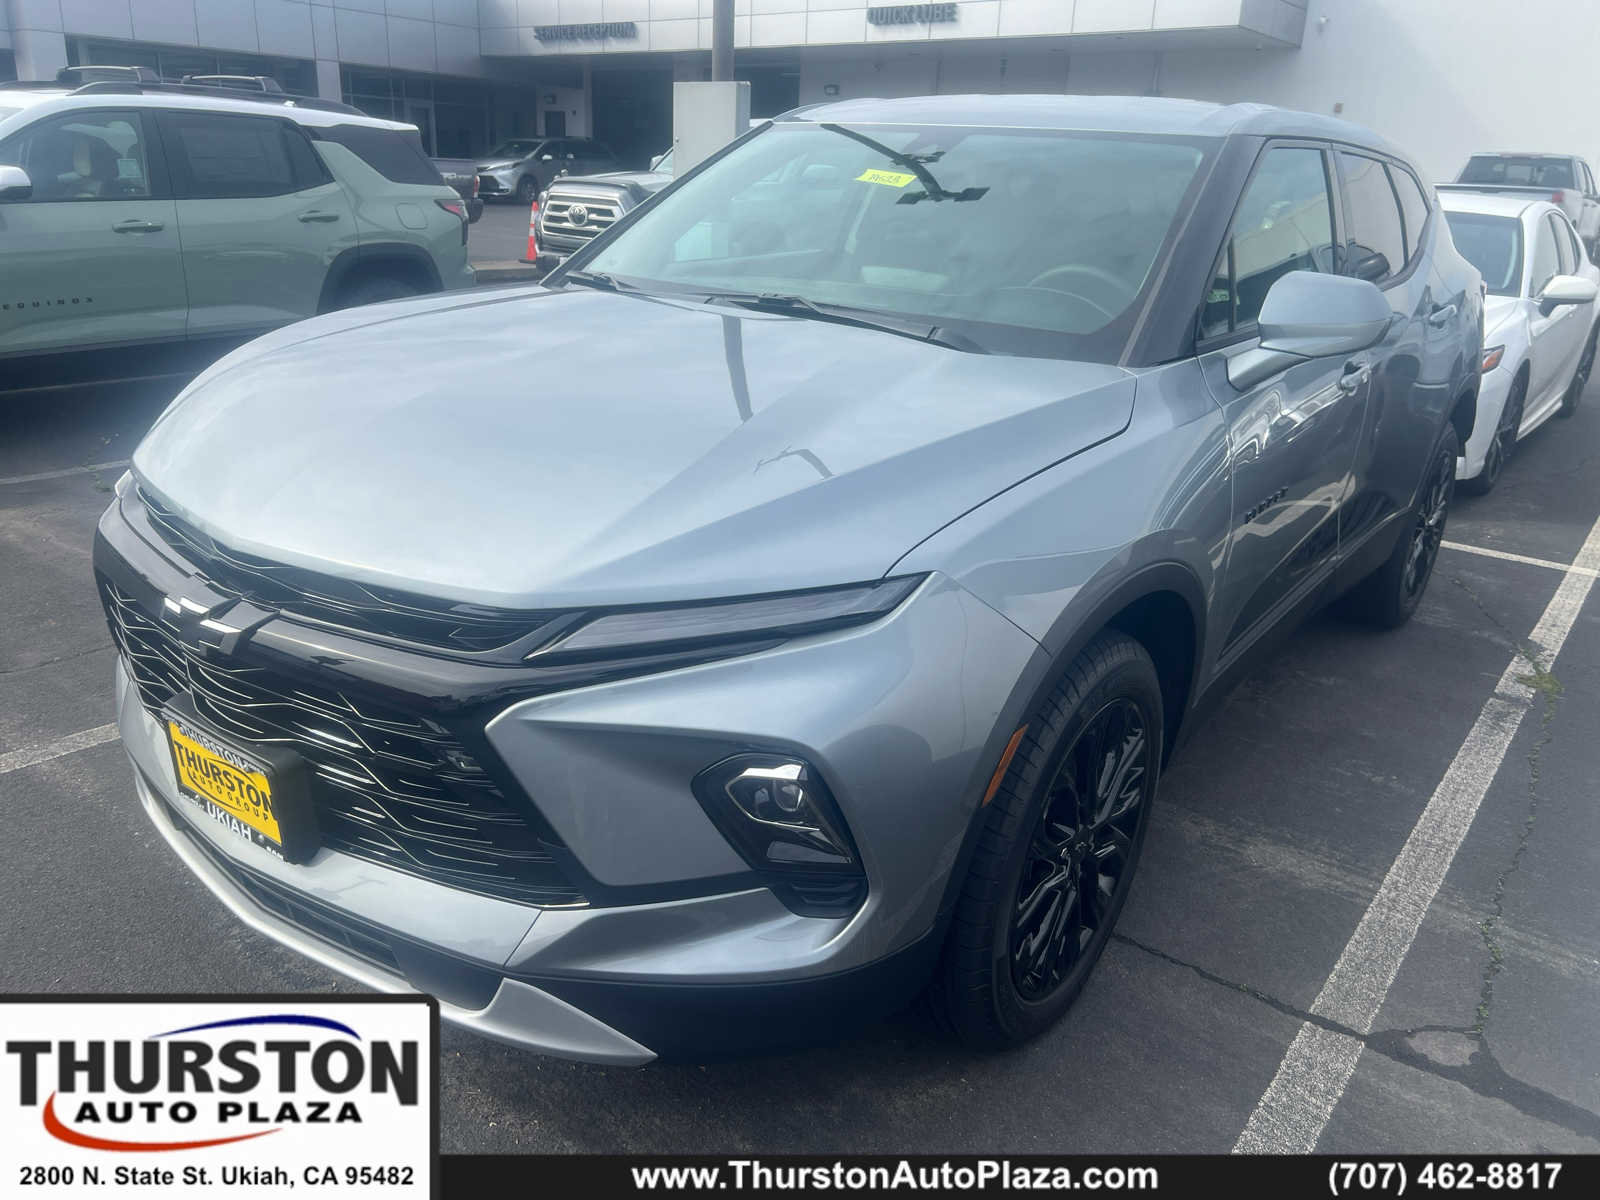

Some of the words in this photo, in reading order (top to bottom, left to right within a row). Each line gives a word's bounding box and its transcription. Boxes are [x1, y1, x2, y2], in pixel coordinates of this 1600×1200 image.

[868, 6, 914, 25] QUICK
[913, 3, 958, 23] LUBE
[174, 740, 272, 813] THURSTON
[207, 801, 252, 842] UKIAH
